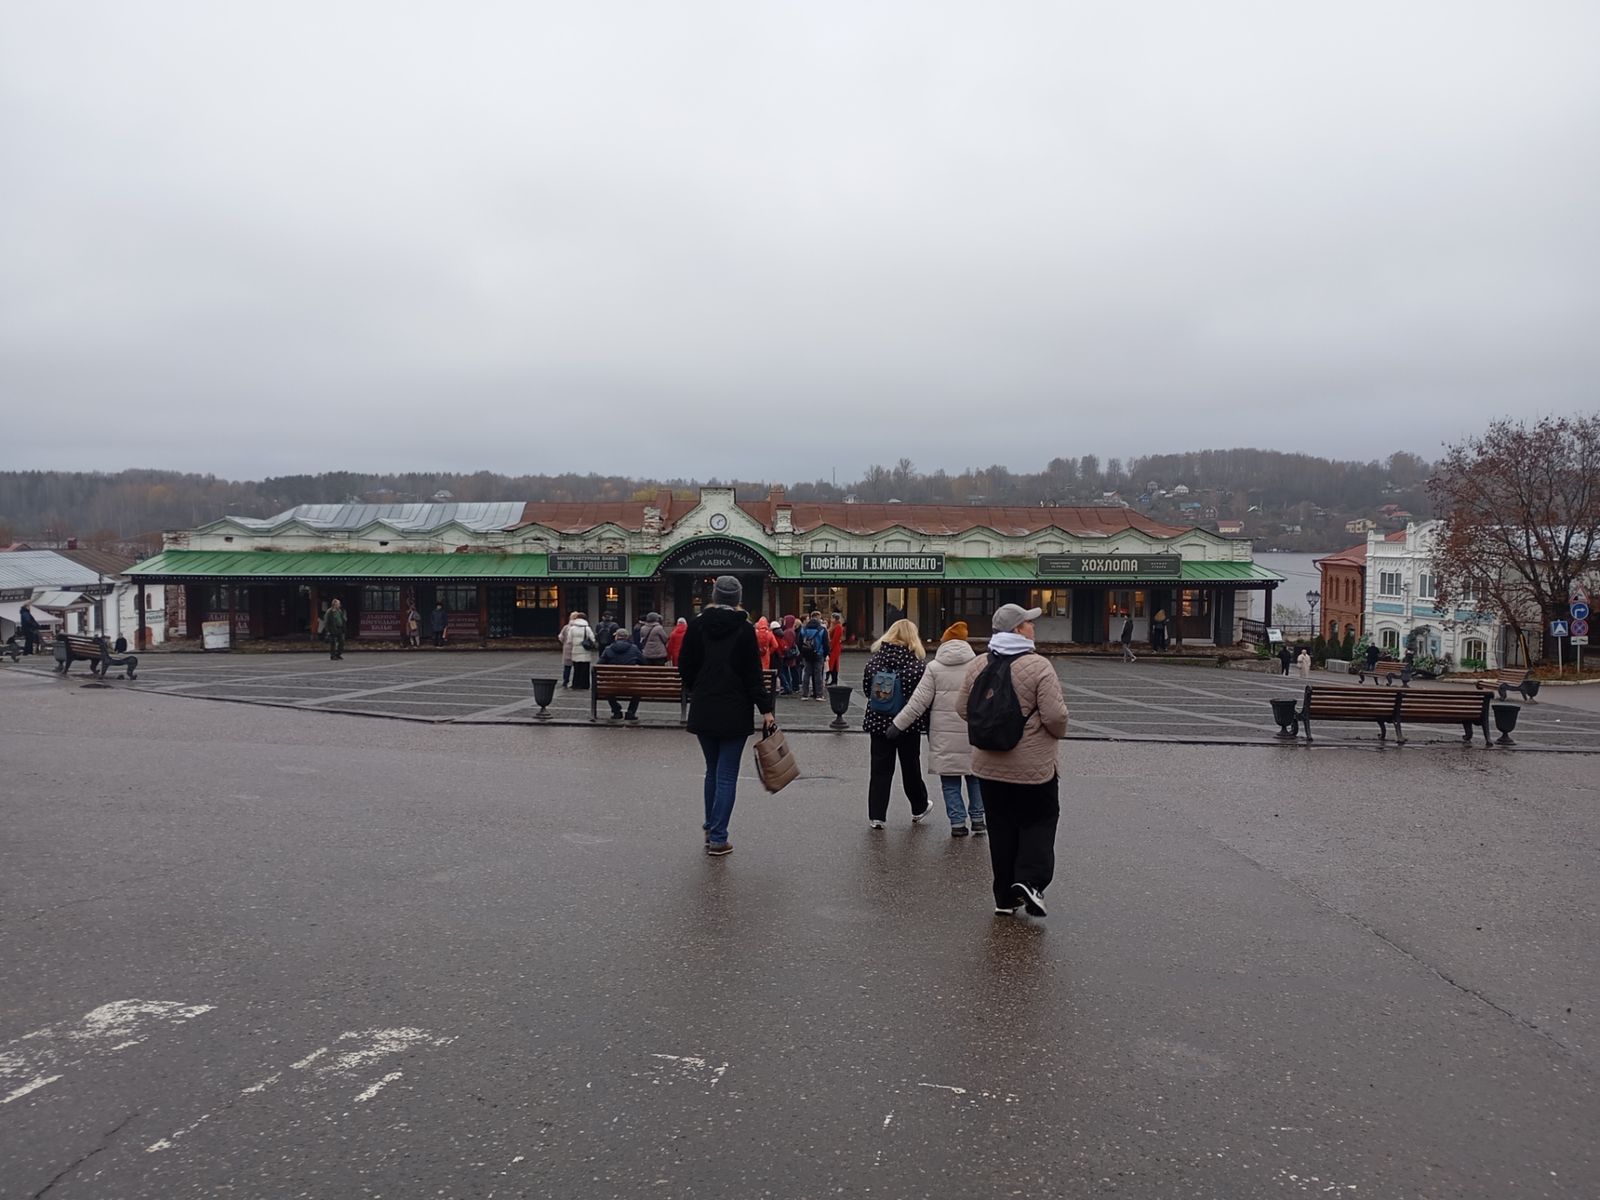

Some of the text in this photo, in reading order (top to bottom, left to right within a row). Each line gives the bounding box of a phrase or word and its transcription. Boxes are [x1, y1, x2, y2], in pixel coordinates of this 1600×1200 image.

[678, 548, 754, 566] ПАРФЮМЕРНАЯ
[810, 556, 858, 570] КОФЕЙНАЯ
[578, 561, 619, 570] ГРОШЕВА
[1081, 559, 1138, 572] ХОХЛОМА
